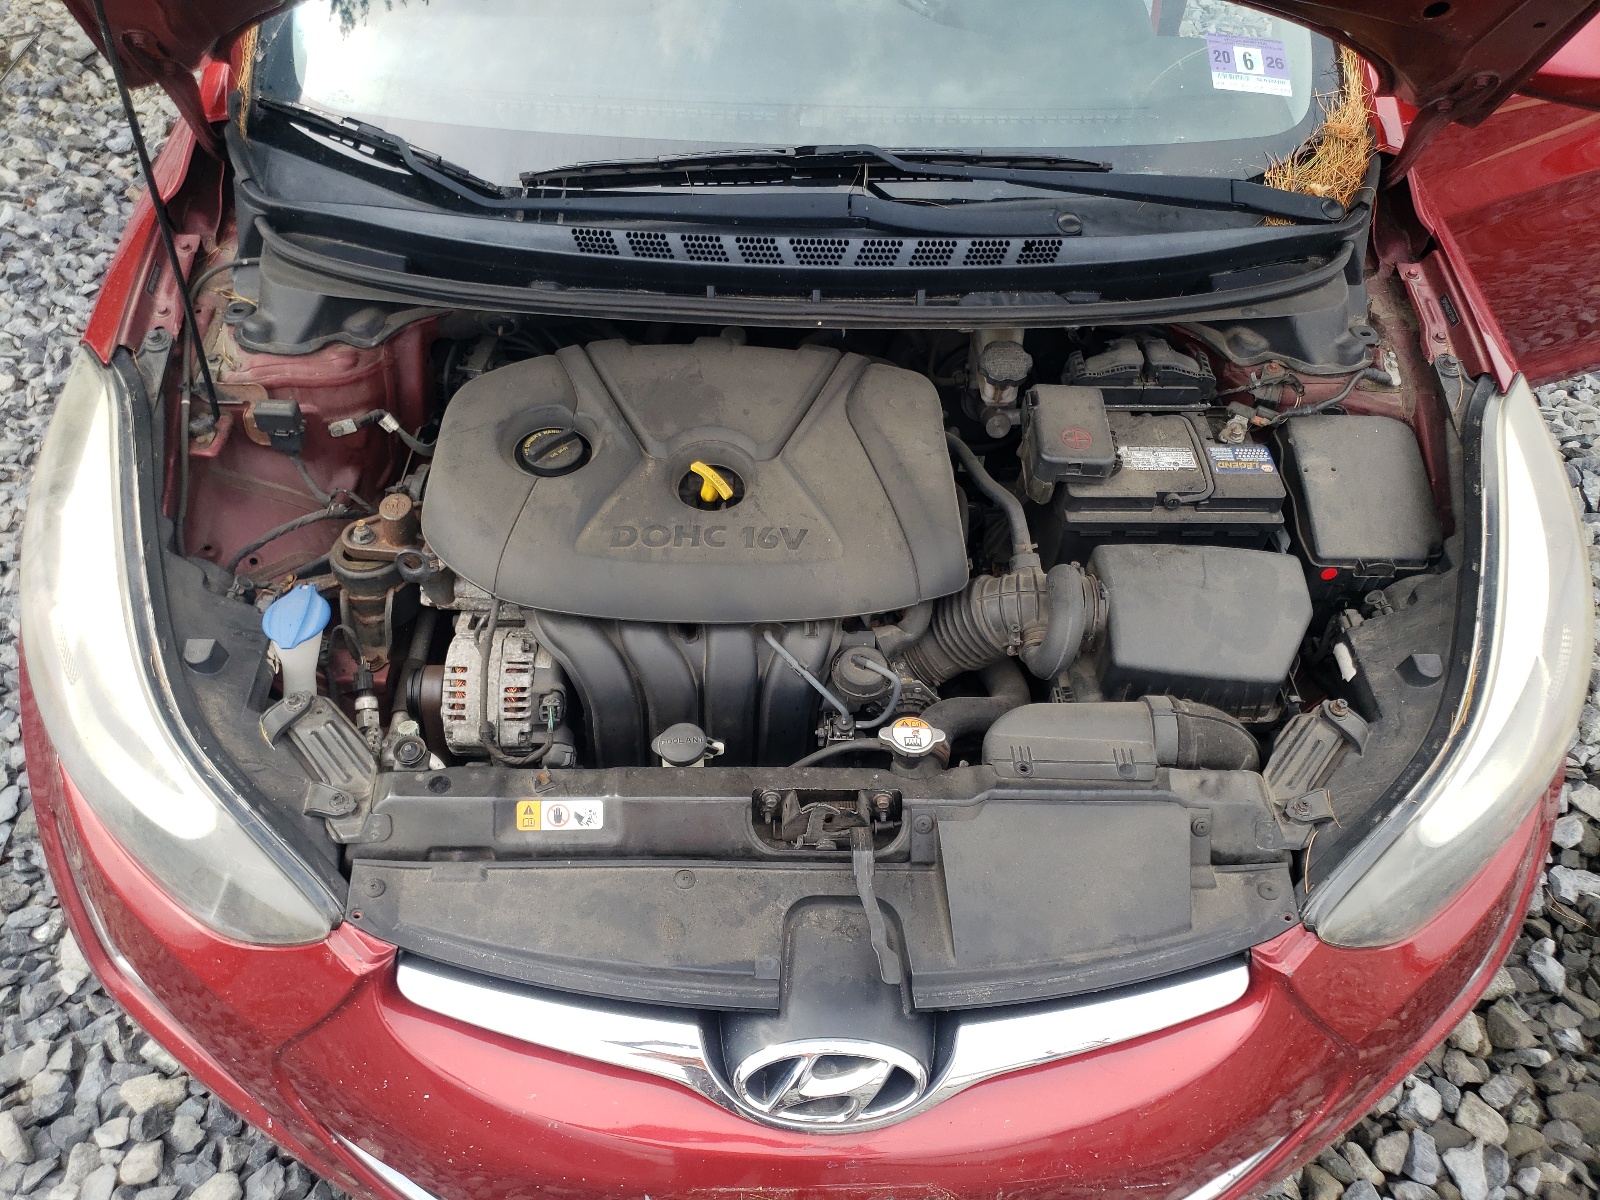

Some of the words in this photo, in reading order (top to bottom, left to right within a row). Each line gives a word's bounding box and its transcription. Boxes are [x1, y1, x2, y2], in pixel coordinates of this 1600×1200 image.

[1213, 49, 1231, 64] 20
[1242, 51, 1255, 71] 6
[1265, 56, 1285, 70] 26
[1217, 461, 1259, 469] LEGEND
[609, 525, 727, 548] DOHC
[740, 526, 809, 550] 16V
[660, 736, 704, 745] COOLANT
